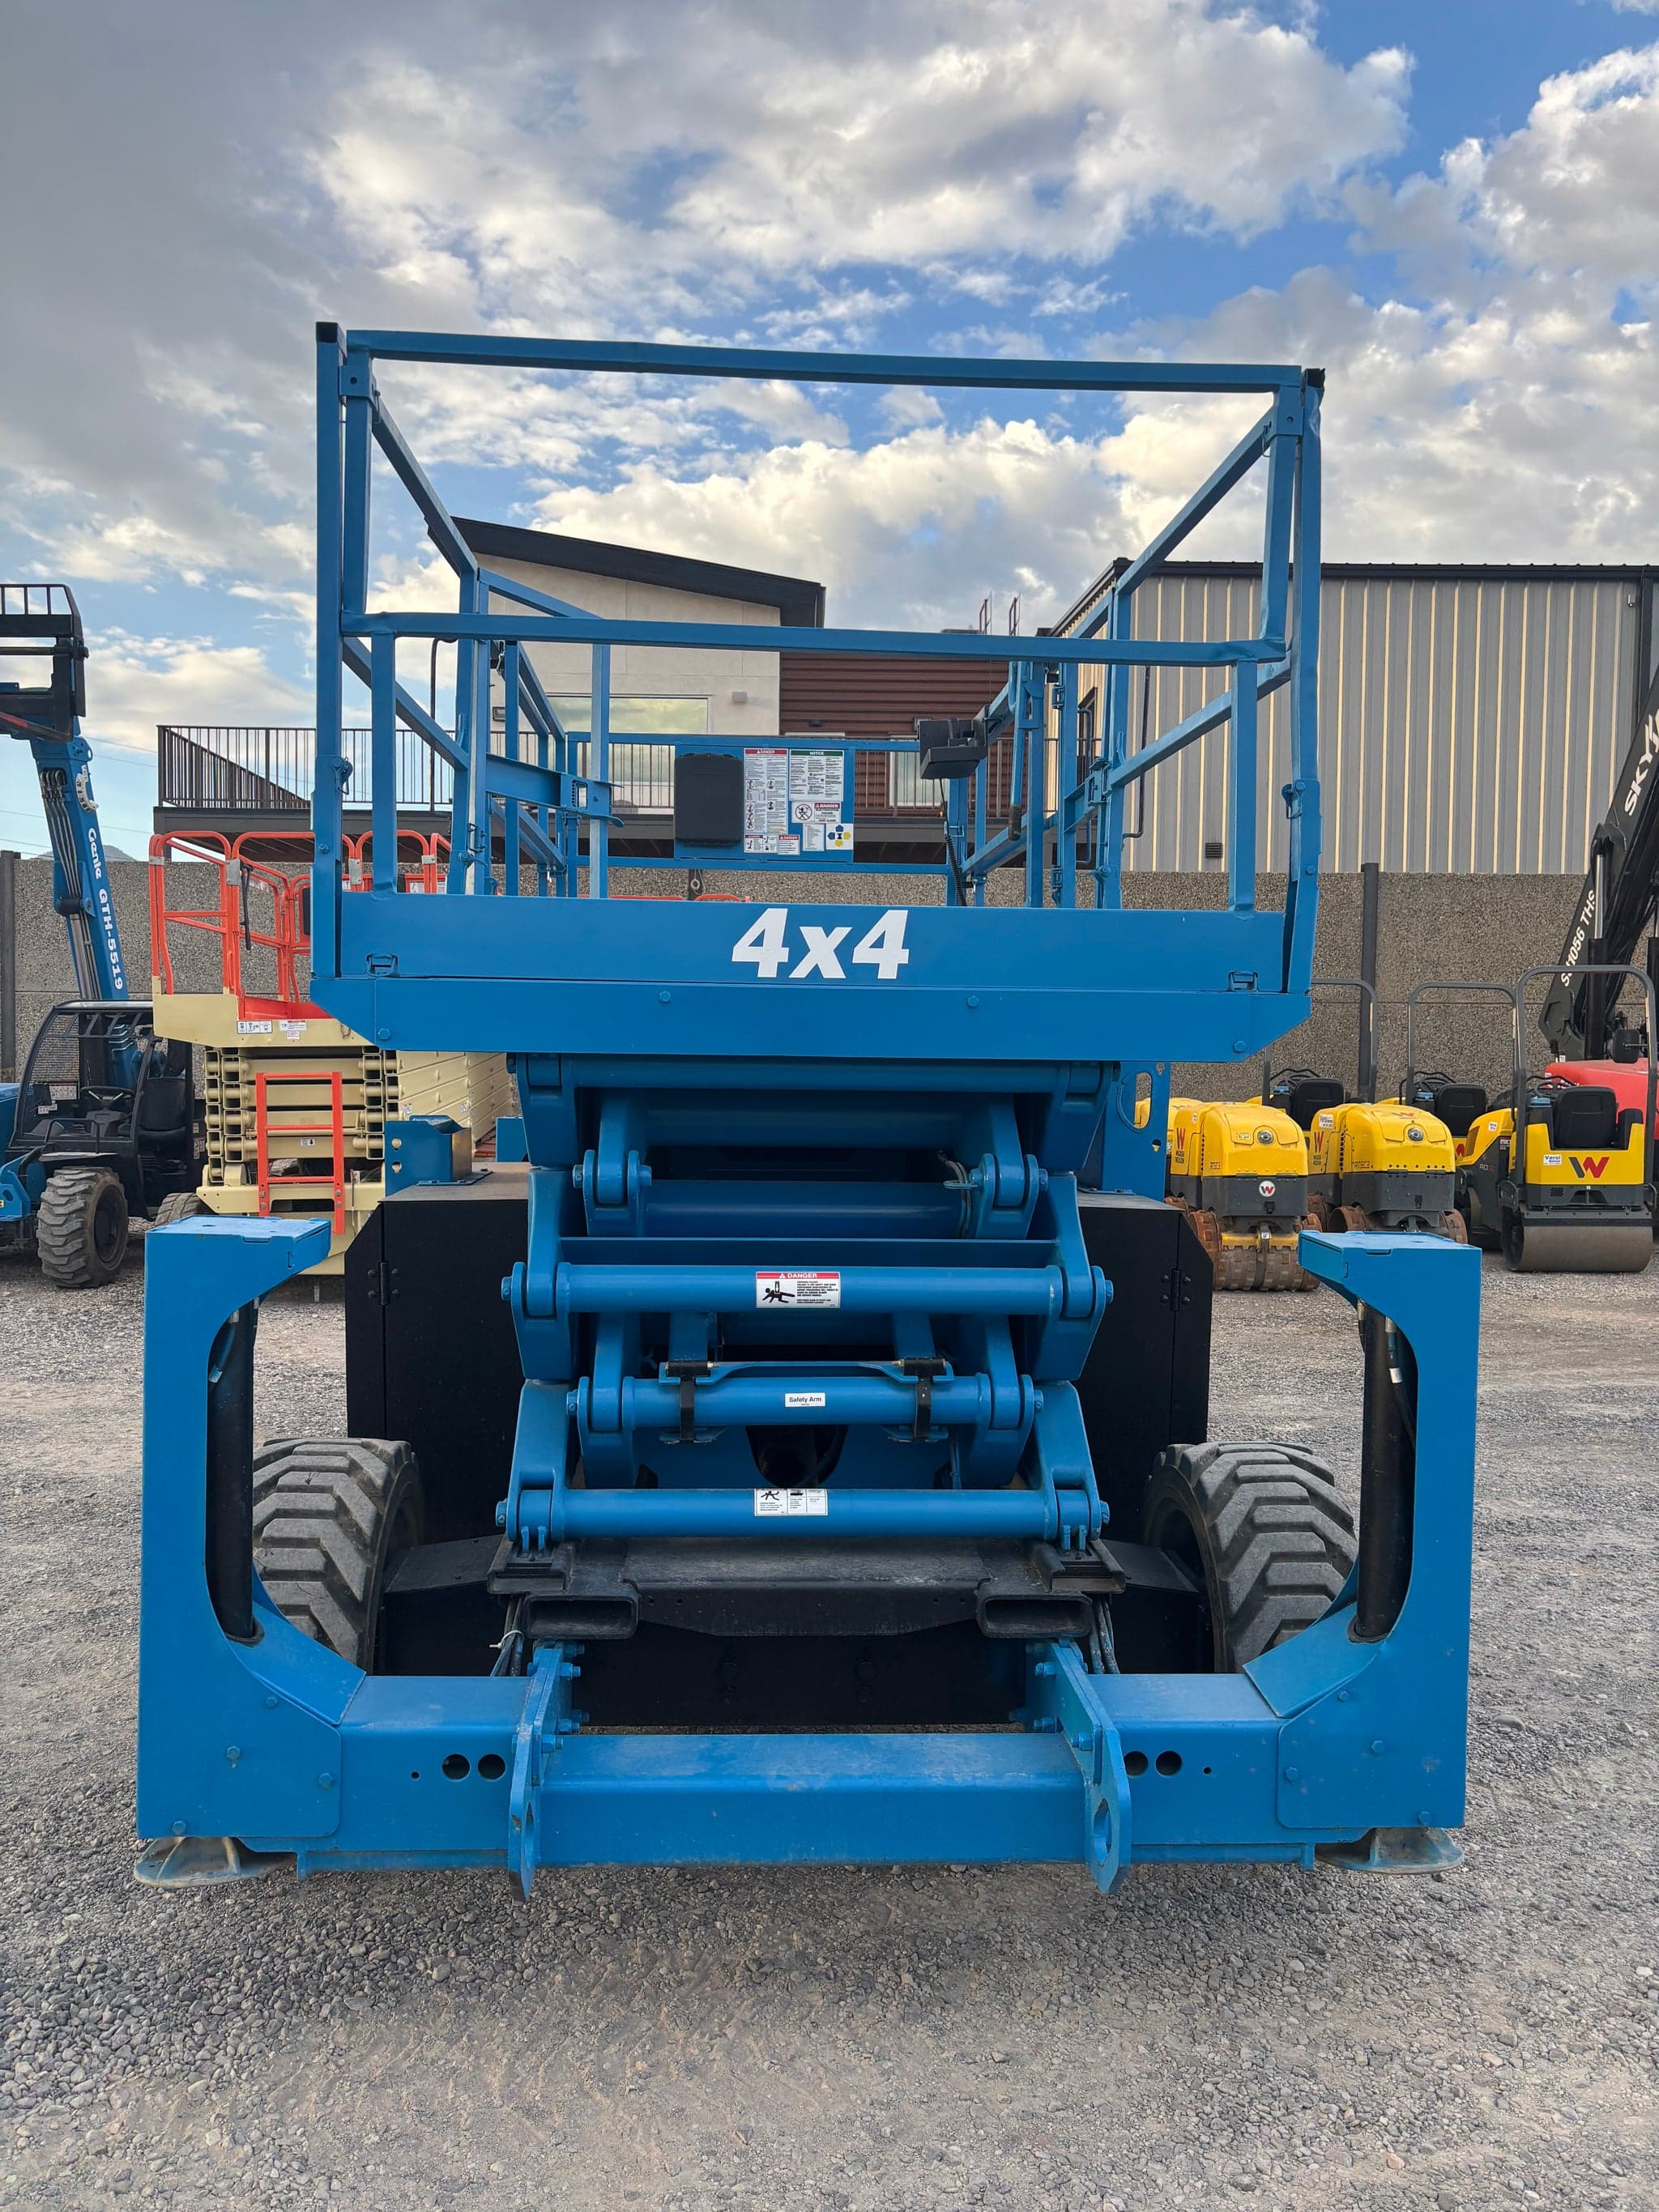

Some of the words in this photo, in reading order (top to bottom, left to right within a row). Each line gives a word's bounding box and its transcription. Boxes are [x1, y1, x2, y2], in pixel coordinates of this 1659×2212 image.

[1624, 708, 1659, 816] SKYJ
[87, 828, 102, 880] Genie
[99, 889, 123, 990] GTH-5519
[731, 908, 910, 978] 4x4
[1568, 1157, 1610, 1178] W
